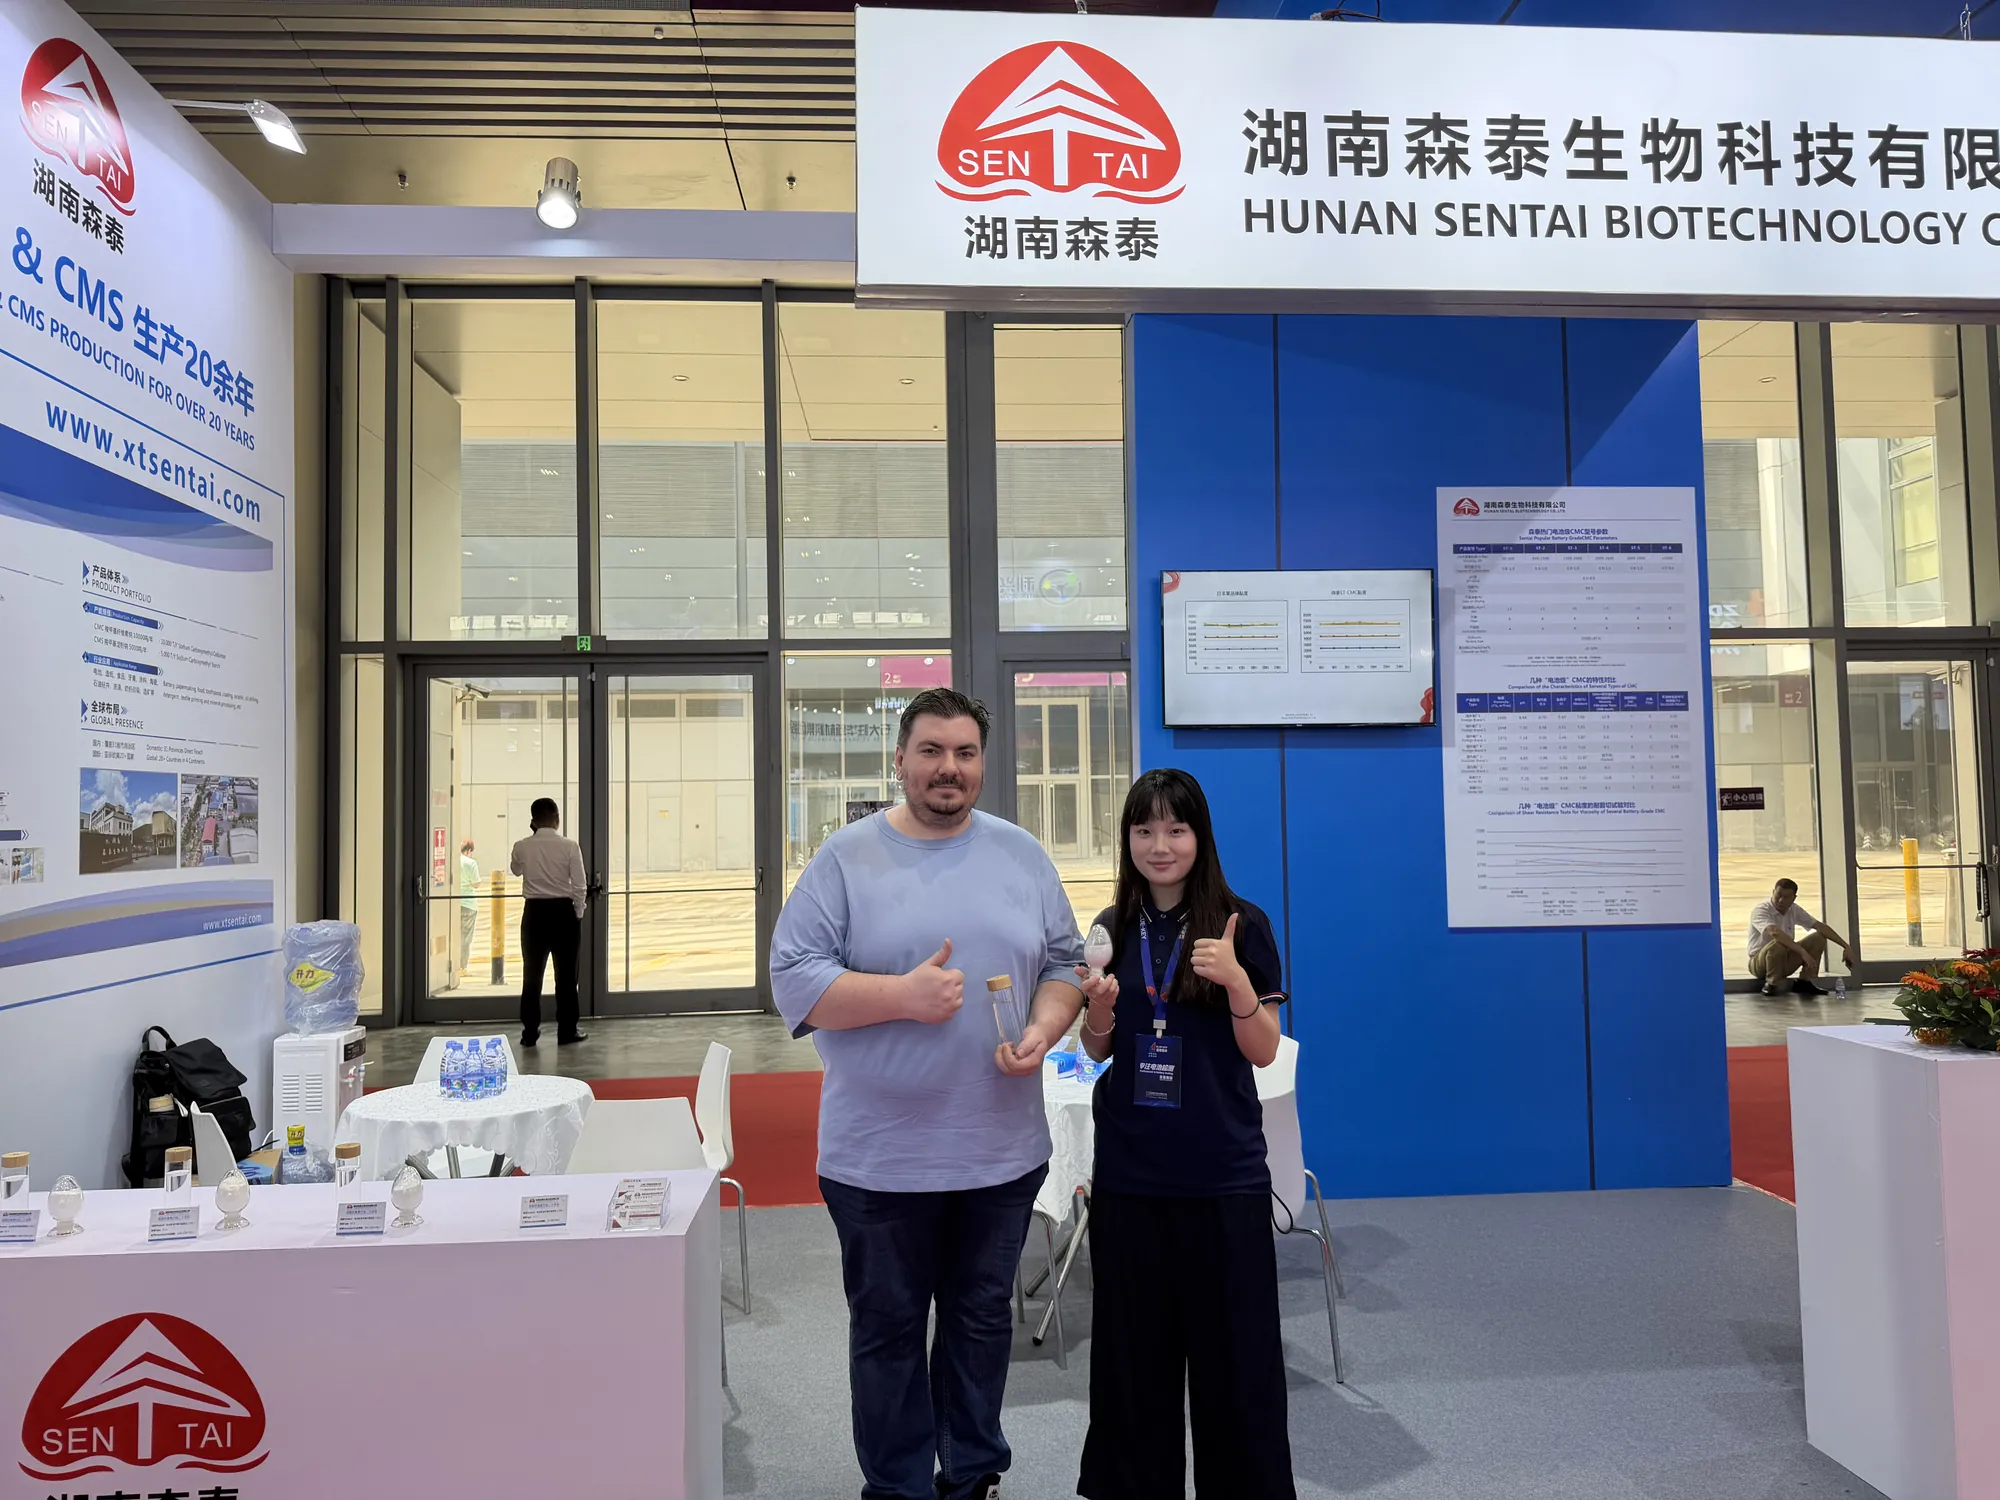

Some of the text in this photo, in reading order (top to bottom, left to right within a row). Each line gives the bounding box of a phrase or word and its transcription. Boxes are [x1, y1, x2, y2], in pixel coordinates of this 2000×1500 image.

[957, 149, 1147, 179] SEN TAI
[1242, 108, 2000, 191] 湖南森泰生物科技有限
[96, 153, 121, 192] TAI
[33, 158, 124, 255] 湖南森泰
[1244, 198, 1417, 236] HUNAN
[1434, 201, 1587, 238] SENTAI
[1605, 205, 1967, 245] BIOTECHNOLOGY
[964, 215, 1159, 261] 湖南森泰
[12, 226, 255, 418] & CMS 生产20余年
[8, 295, 255, 451] CMS PRODUCTION FOR OVER 20 YEARS
[46, 401, 260, 523] www.xtsentai.com
[1483, 501, 1566, 509] 湖南森泰生物科技有限公司
[92, 564, 121, 584] 产品体系
[92, 579, 152, 603] PRODUCT PORTFOLIO
[91, 700, 120, 715] 全球布局
[91, 715, 144, 729] GLOBAL PRESENCE
[202, 913, 262, 931] www.xtsentai.com
[41, 1422, 232, 1455] SEN TAI
